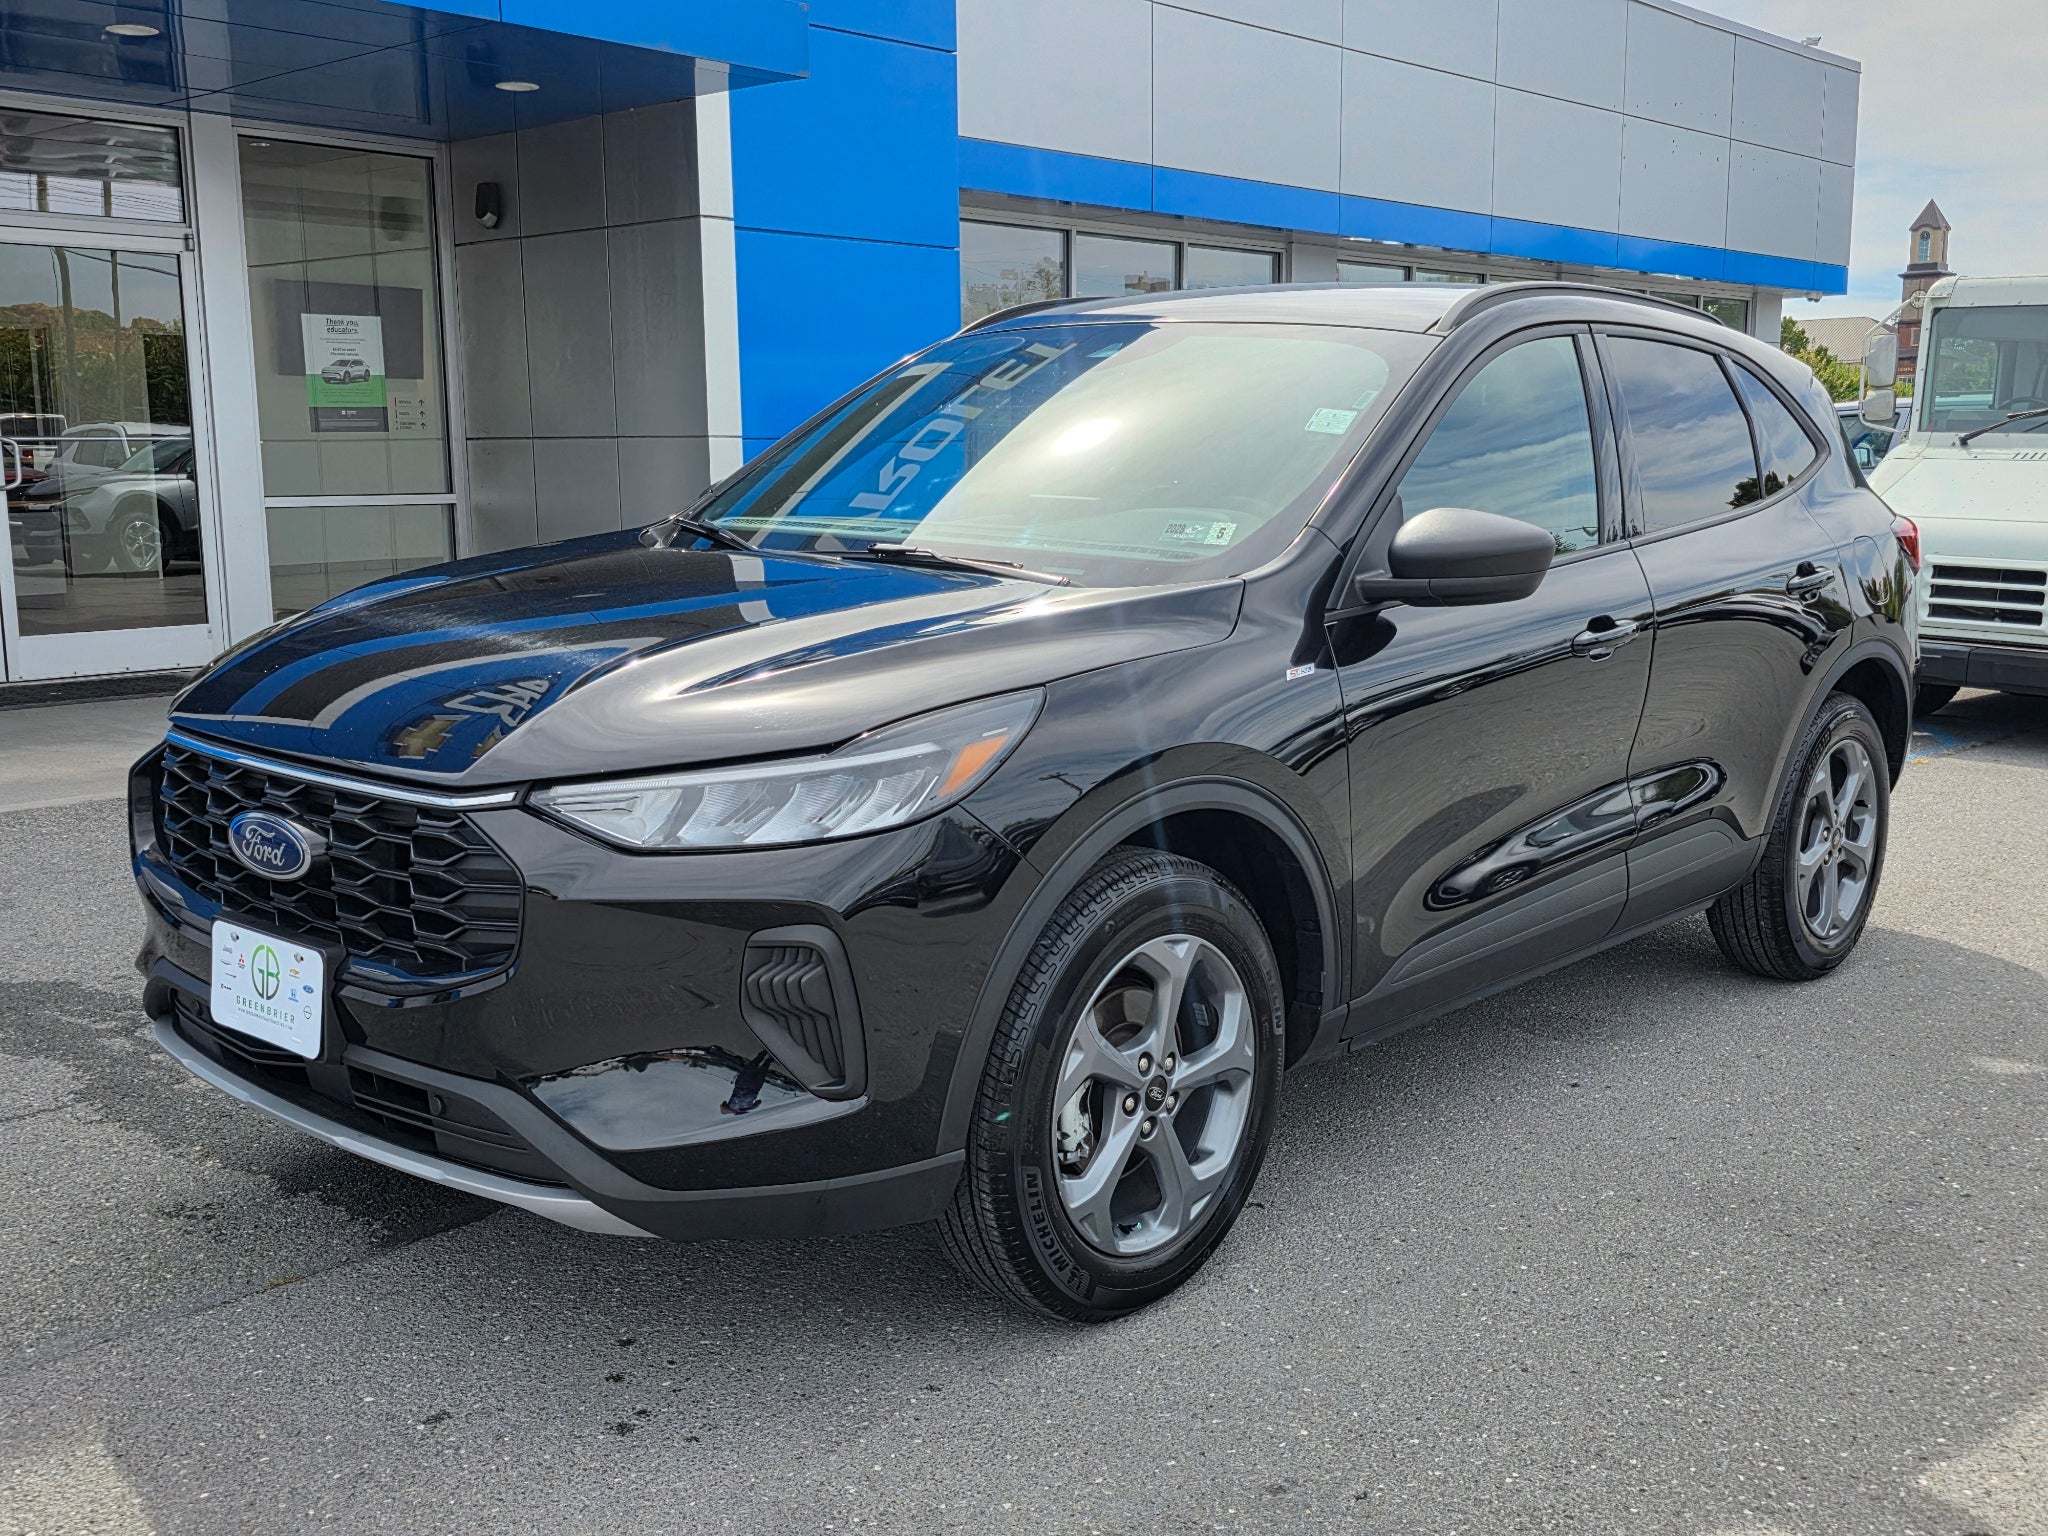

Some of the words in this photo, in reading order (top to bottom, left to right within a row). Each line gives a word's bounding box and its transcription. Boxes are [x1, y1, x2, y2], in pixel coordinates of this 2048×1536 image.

[1216, 526, 1227, 540] 5
[241, 825, 286, 867] Ford
[236, 995, 295, 1025] GREENBRIER
[1026, 1173, 1070, 1273] MICHELIN
